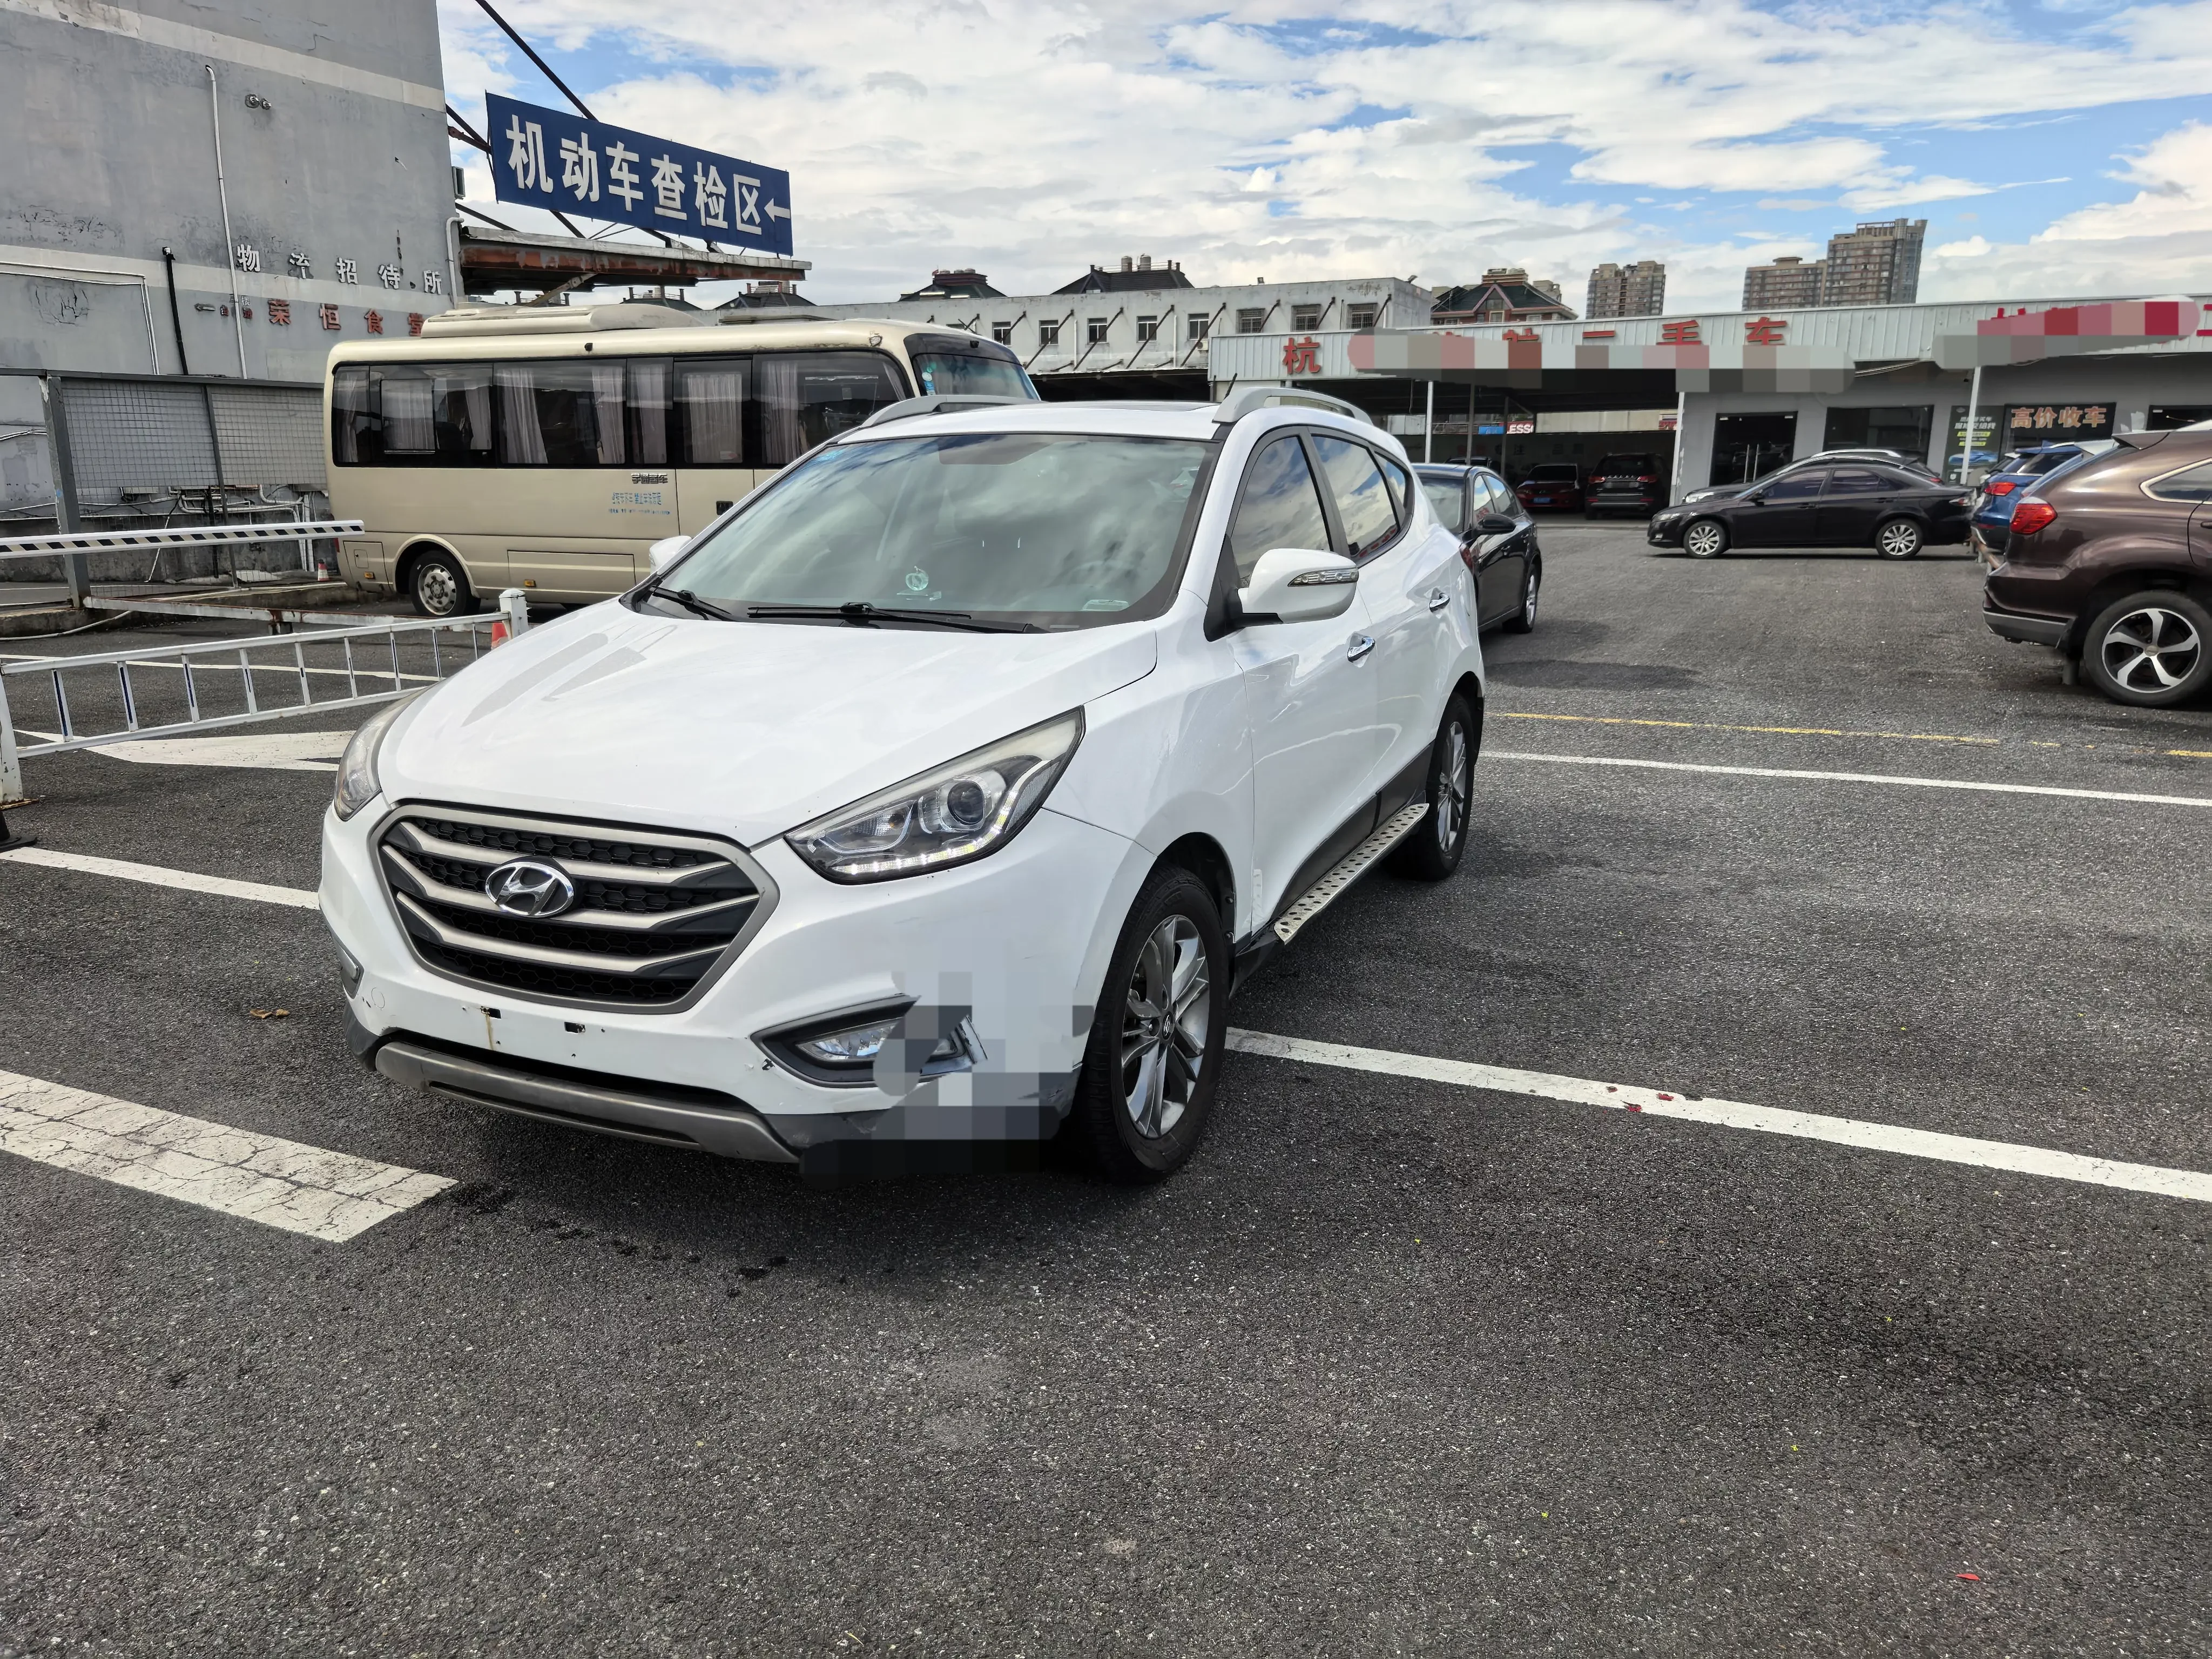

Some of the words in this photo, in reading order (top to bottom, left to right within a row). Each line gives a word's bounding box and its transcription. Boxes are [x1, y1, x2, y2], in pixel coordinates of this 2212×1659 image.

[506, 114, 762, 235] 机动车查检区
[2011, 407, 2107, 429] 高价收车
